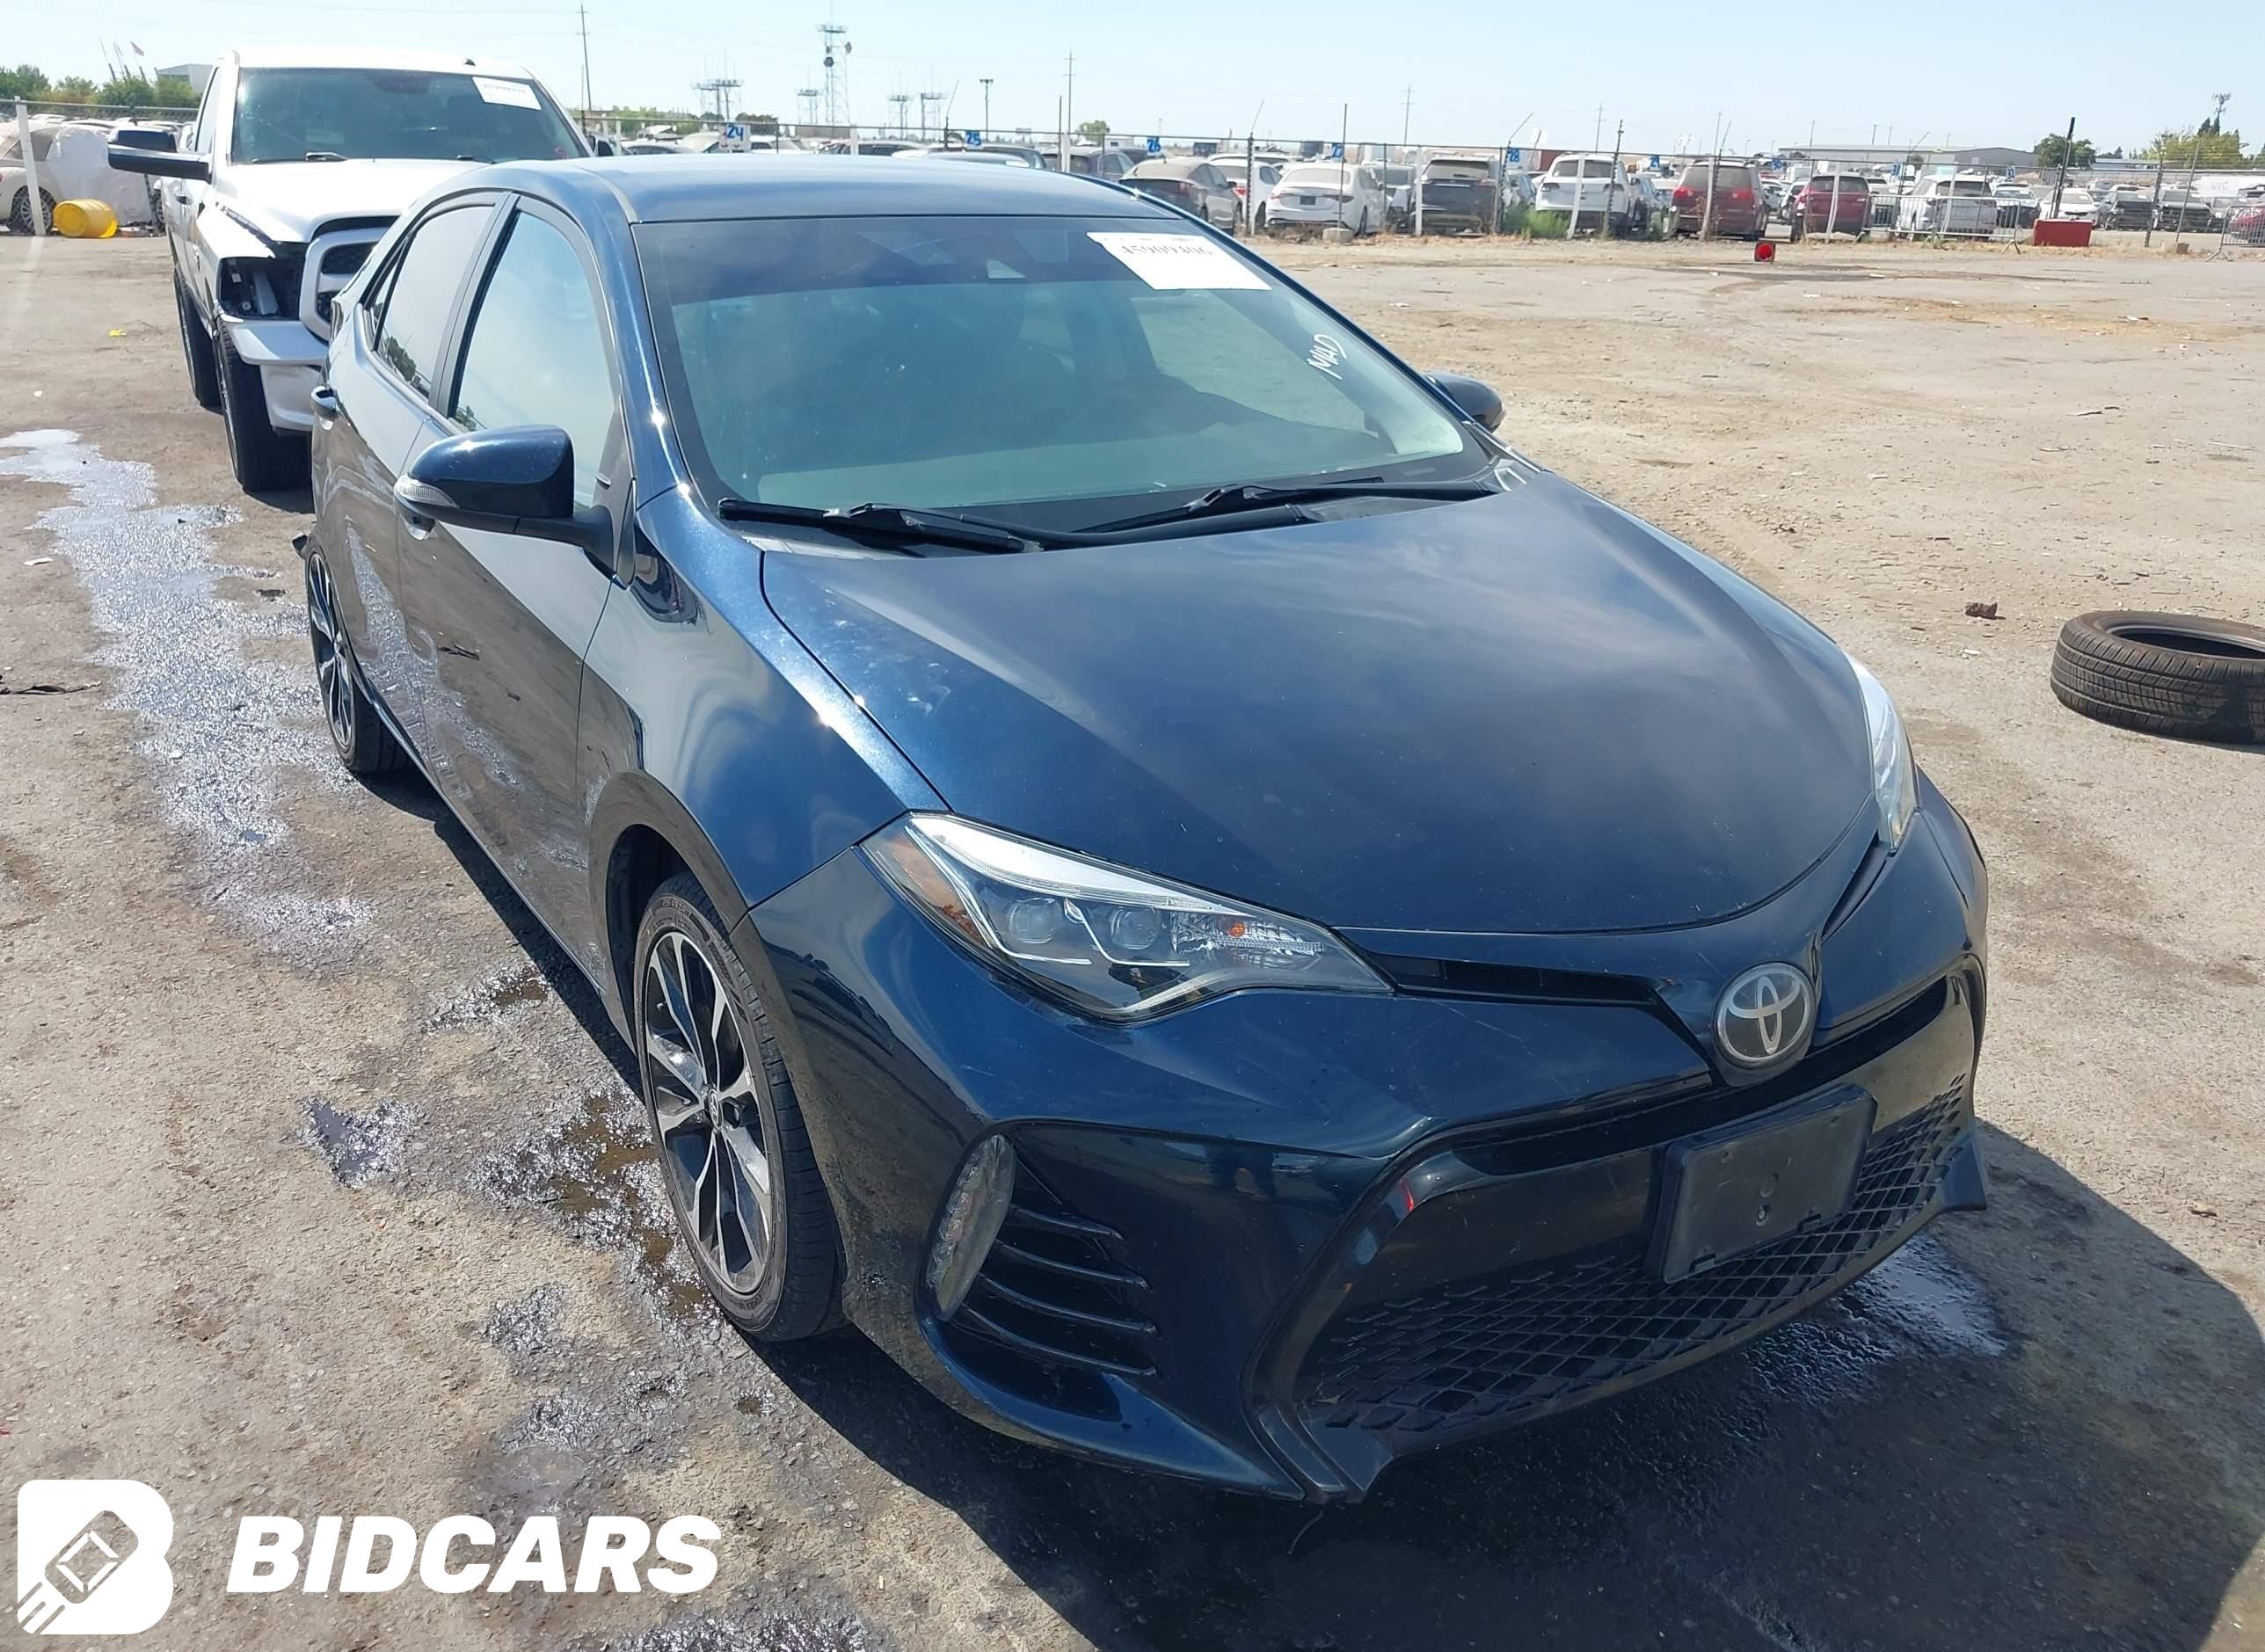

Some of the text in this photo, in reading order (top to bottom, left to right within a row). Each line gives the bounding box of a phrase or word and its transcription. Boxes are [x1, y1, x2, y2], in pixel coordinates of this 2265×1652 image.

[727, 124, 744, 142] 24
[966, 131, 981, 147] 25
[1147, 137, 1161, 153] 26
[1507, 149, 1519, 163] 28
